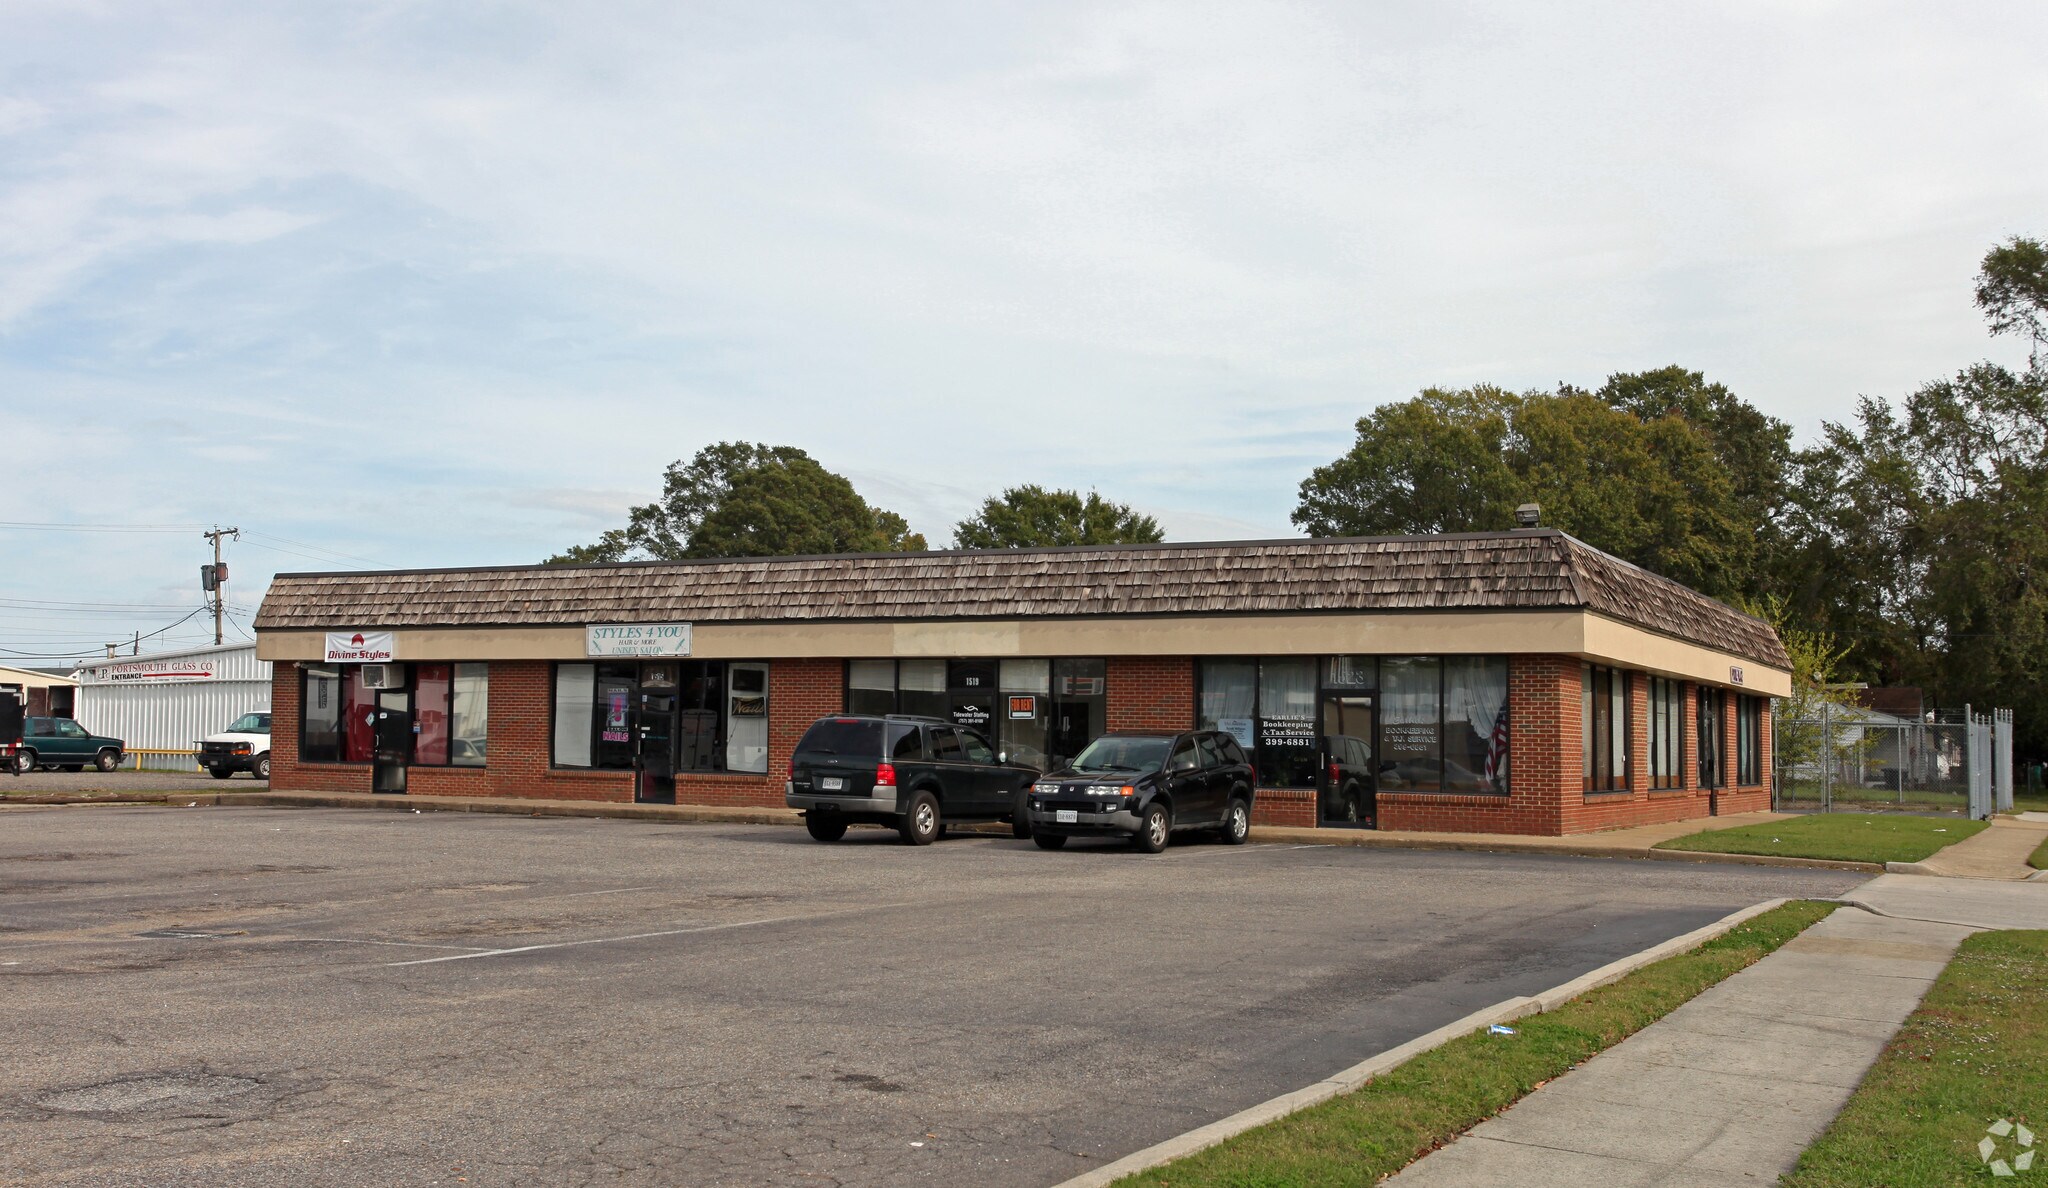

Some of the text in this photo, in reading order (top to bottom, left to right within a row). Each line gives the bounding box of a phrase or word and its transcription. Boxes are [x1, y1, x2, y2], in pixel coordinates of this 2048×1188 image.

[594, 626, 684, 639] STYLES 4 YOU
[328, 650, 390, 660] Divine Styles
[112, 662, 214, 673] PORTSMOUTH GLASS CO.
[966, 677, 979, 686] 1519
[1011, 698, 1033, 711] FOR RENT
[973, 711, 989, 719] Staffing
[1263, 720, 1313, 729] Bookkeeping
[602, 731, 629, 742] NAILS
[1265, 738, 1310, 746] 399-6881
